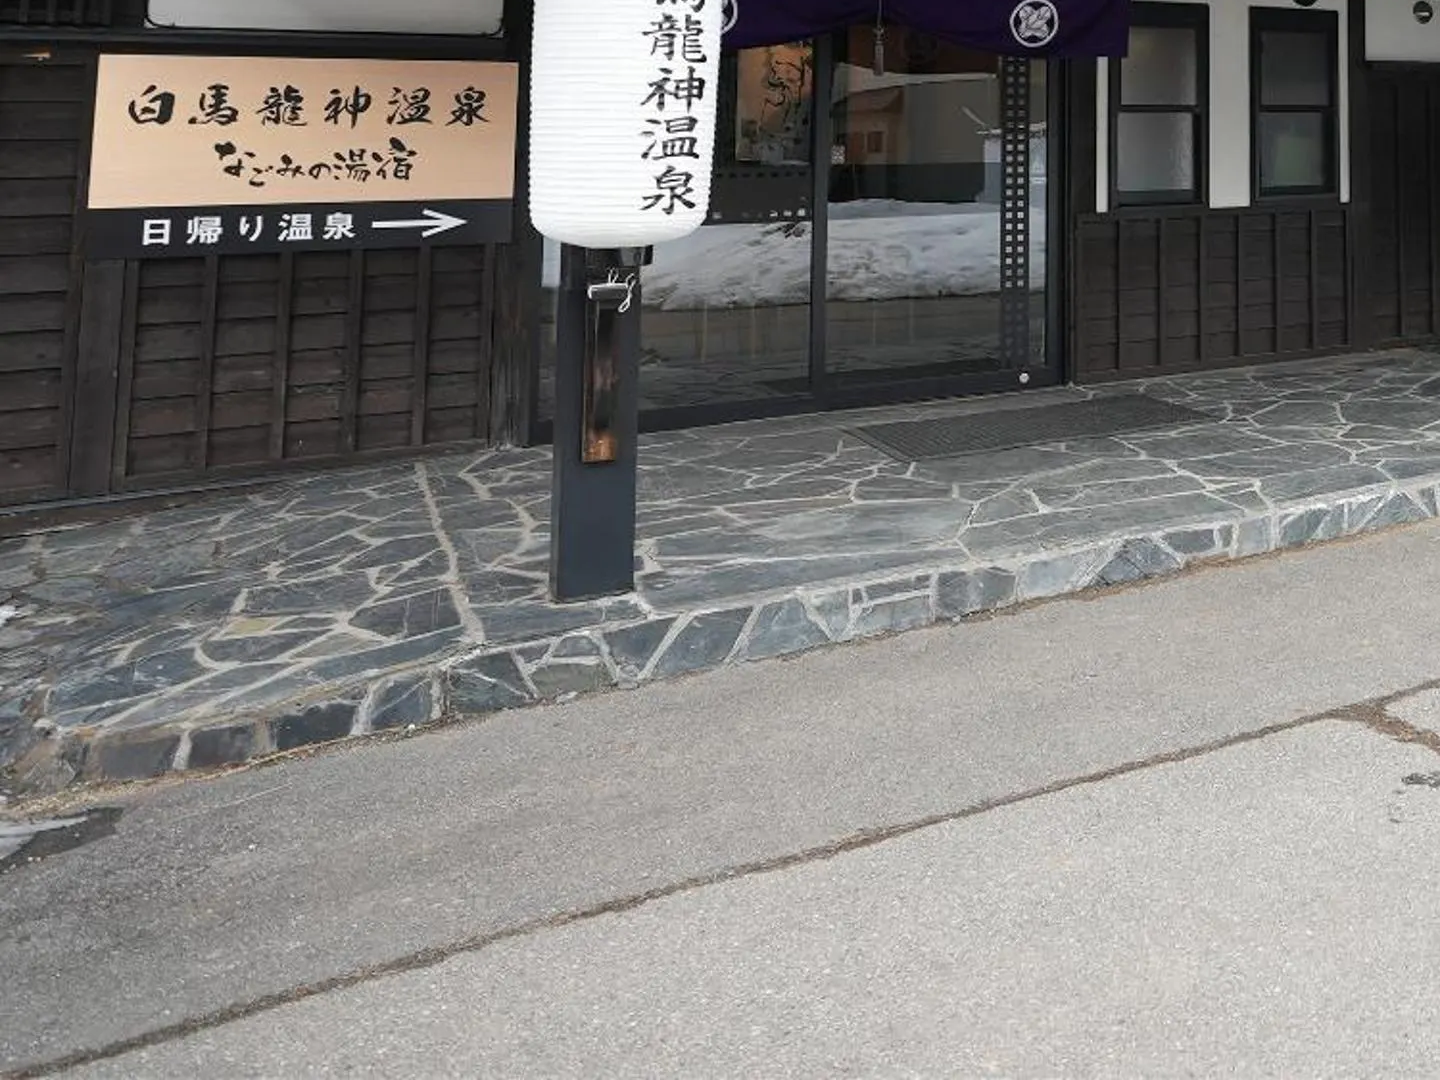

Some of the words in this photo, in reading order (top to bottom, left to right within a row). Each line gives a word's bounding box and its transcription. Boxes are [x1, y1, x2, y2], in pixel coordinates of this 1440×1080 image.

[127, 83, 491, 128] 白馬龍神温泉
[214, 136, 418, 188] なごみの湯宿
[141, 211, 357, 247] 日帰り温泉
